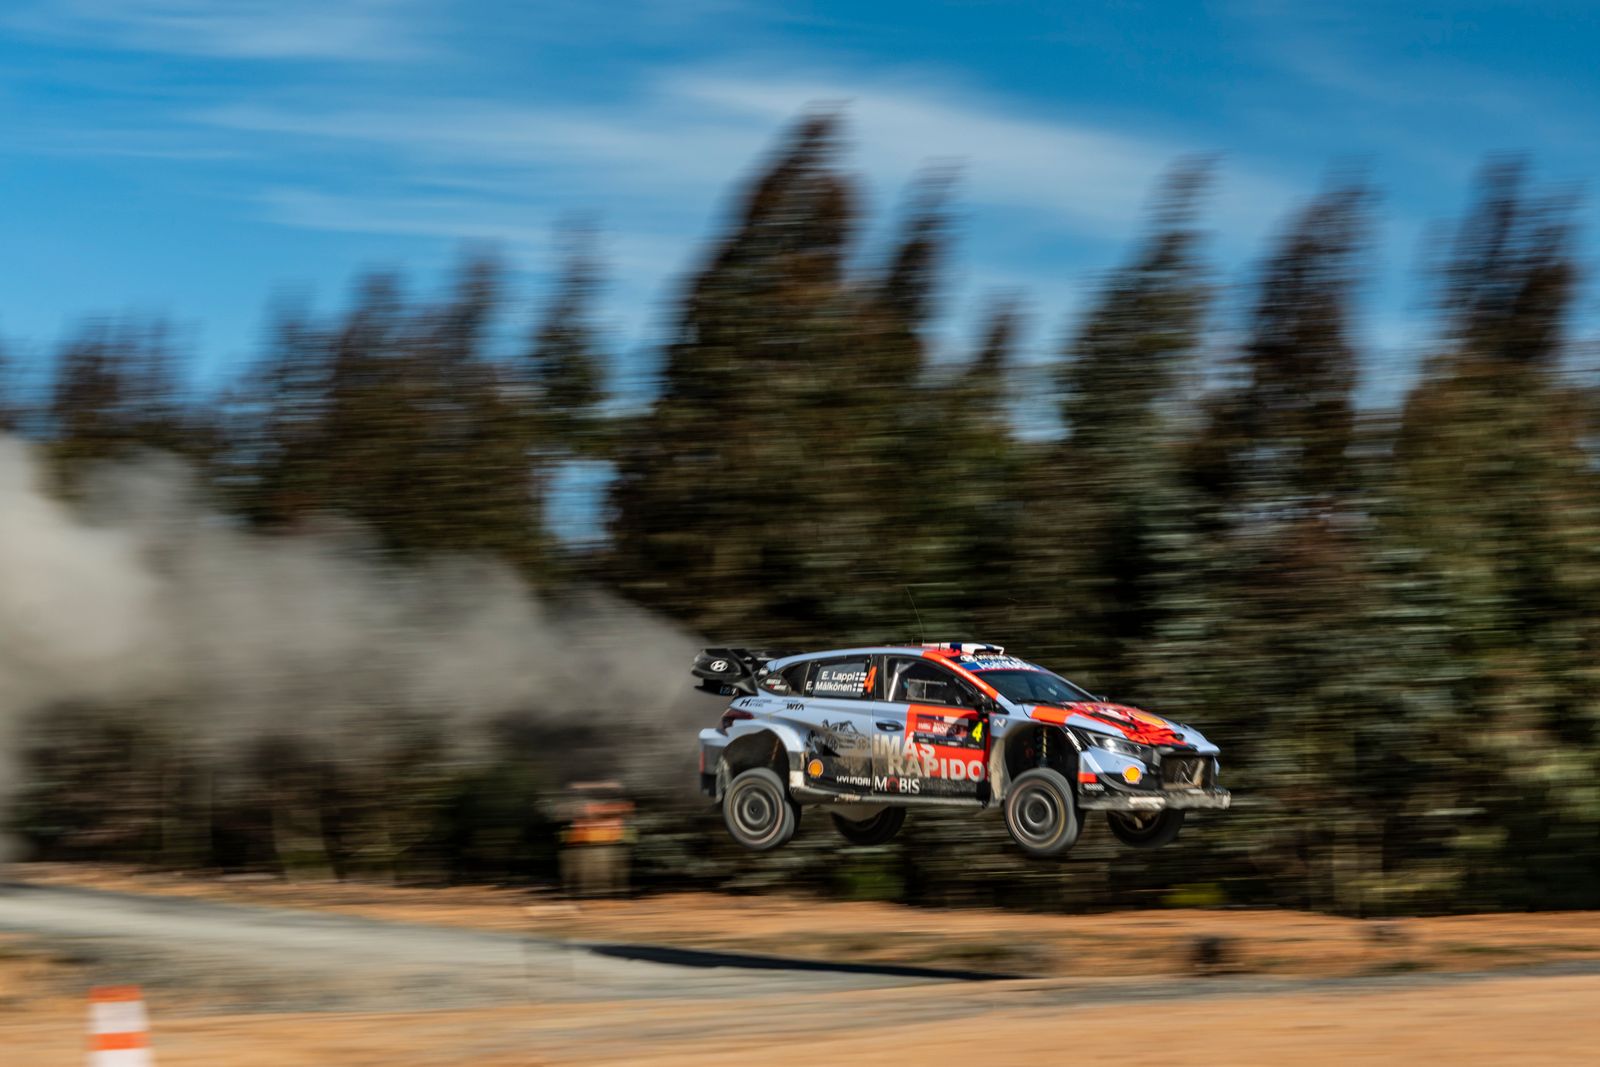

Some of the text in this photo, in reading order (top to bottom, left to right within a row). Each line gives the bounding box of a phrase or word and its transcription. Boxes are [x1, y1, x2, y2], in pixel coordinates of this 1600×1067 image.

[805, 681, 814, 691] E.
[821, 671, 856, 683] E. Lappi
[863, 666, 877, 693] 4
[971, 721, 983, 742] 4
[874, 775, 920, 794] MOBIS
